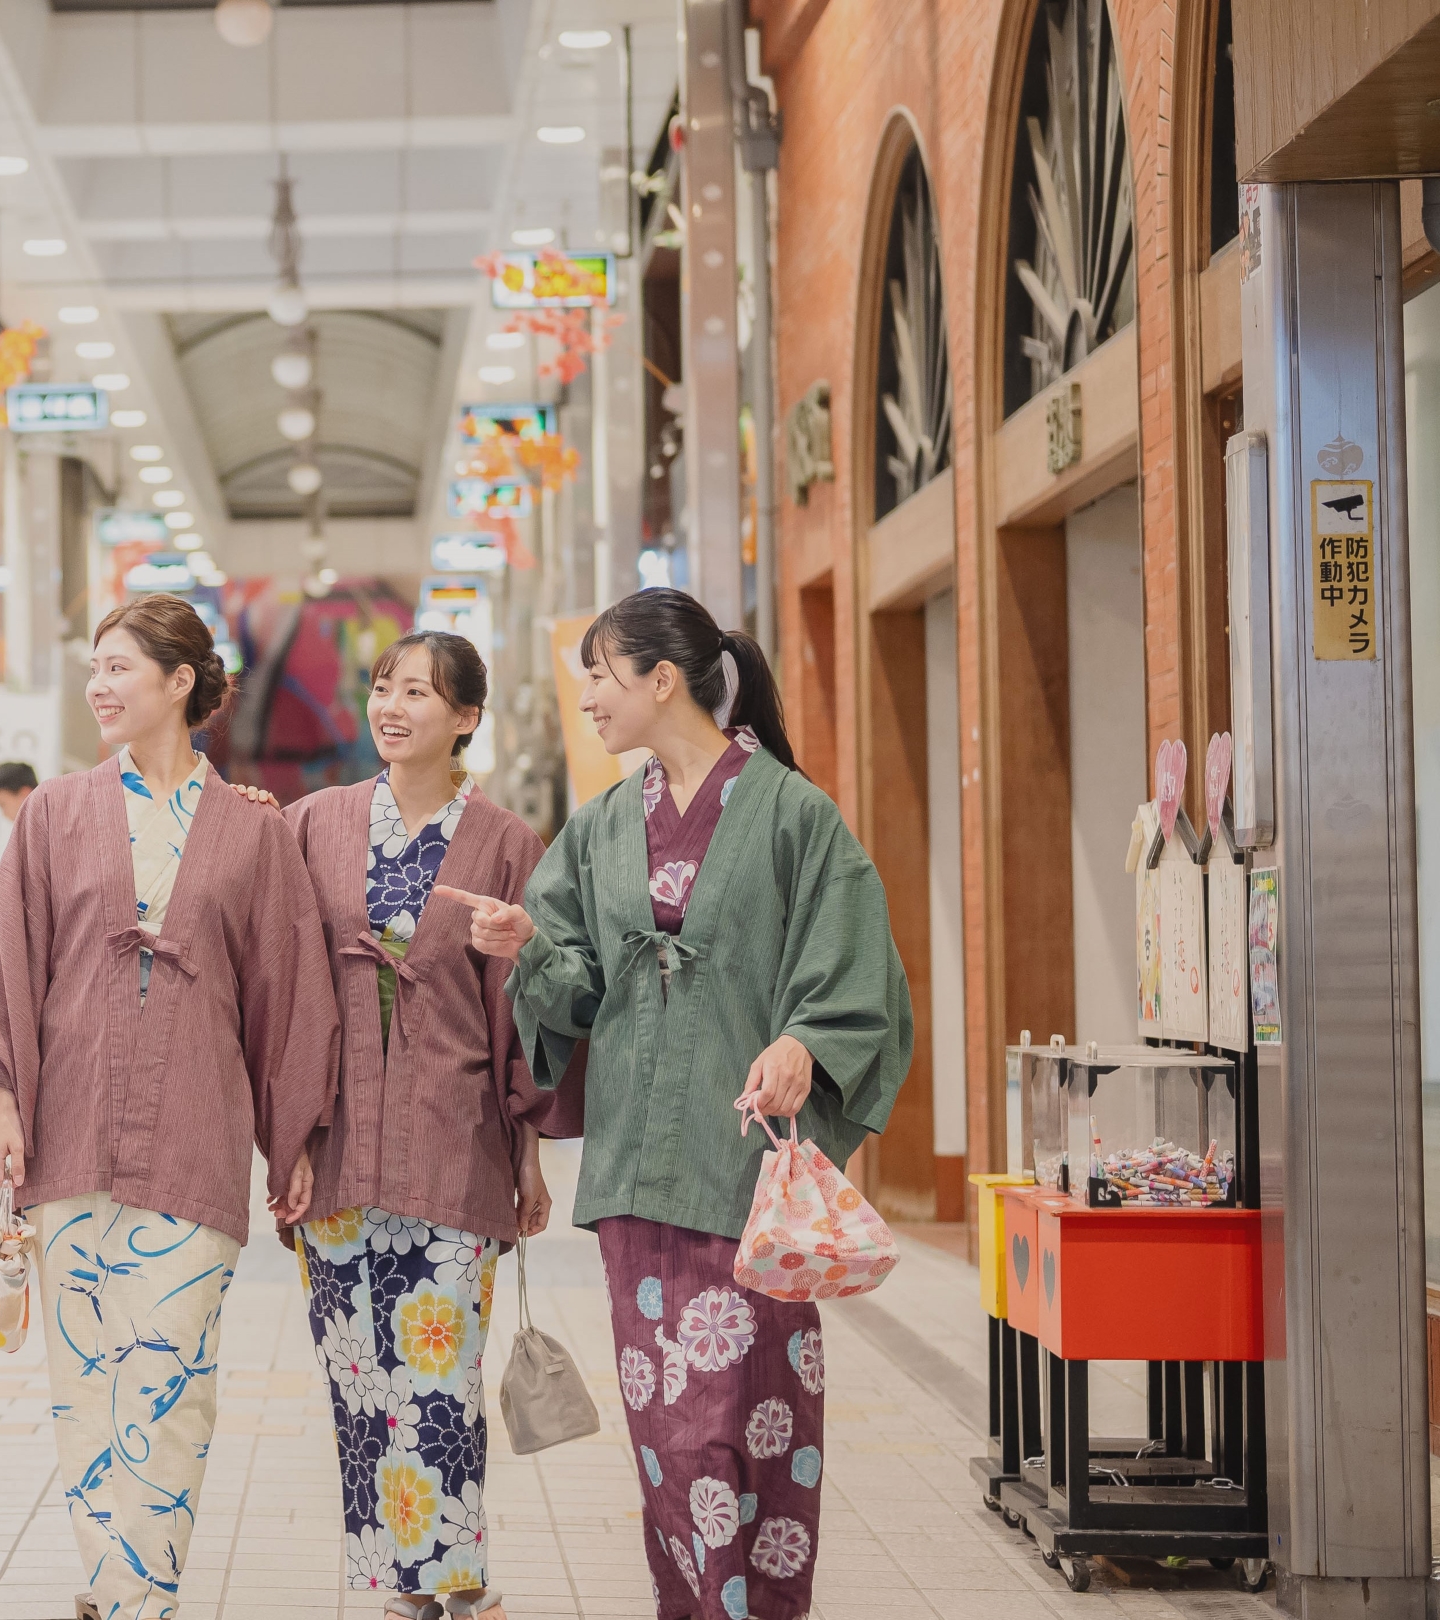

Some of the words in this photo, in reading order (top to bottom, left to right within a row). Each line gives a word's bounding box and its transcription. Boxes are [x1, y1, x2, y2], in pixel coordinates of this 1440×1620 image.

[1319, 537, 1344, 607] 作動中
[1345, 537, 1370, 654] 防犯カメラ
